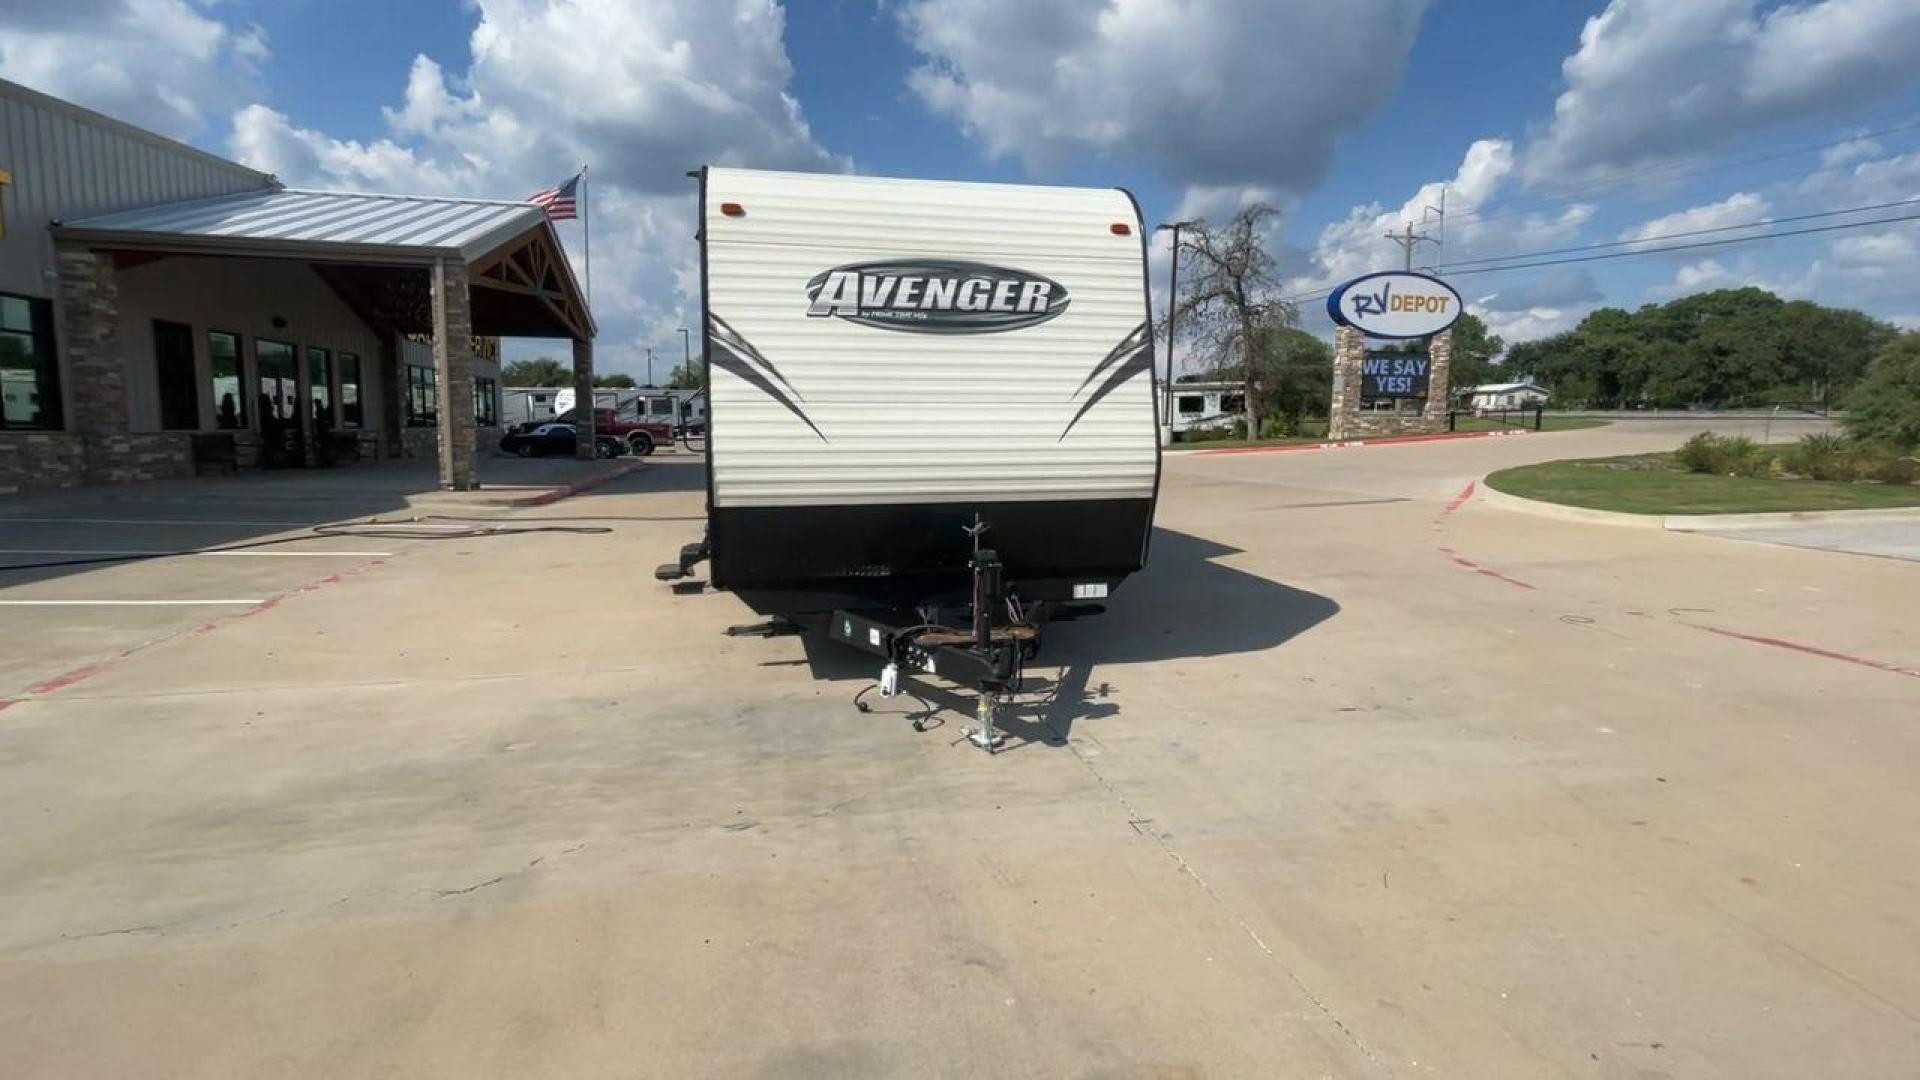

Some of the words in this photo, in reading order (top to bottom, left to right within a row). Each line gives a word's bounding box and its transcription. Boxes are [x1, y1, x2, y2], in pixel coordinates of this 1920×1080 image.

[806, 271, 1051, 317] AVENGER
[1352, 282, 1390, 319] RV
[1391, 294, 1449, 313] DEPOT
[1363, 359, 1389, 376] WE
[1394, 359, 1427, 376] SAY
[1376, 376, 1411, 393] YES!
